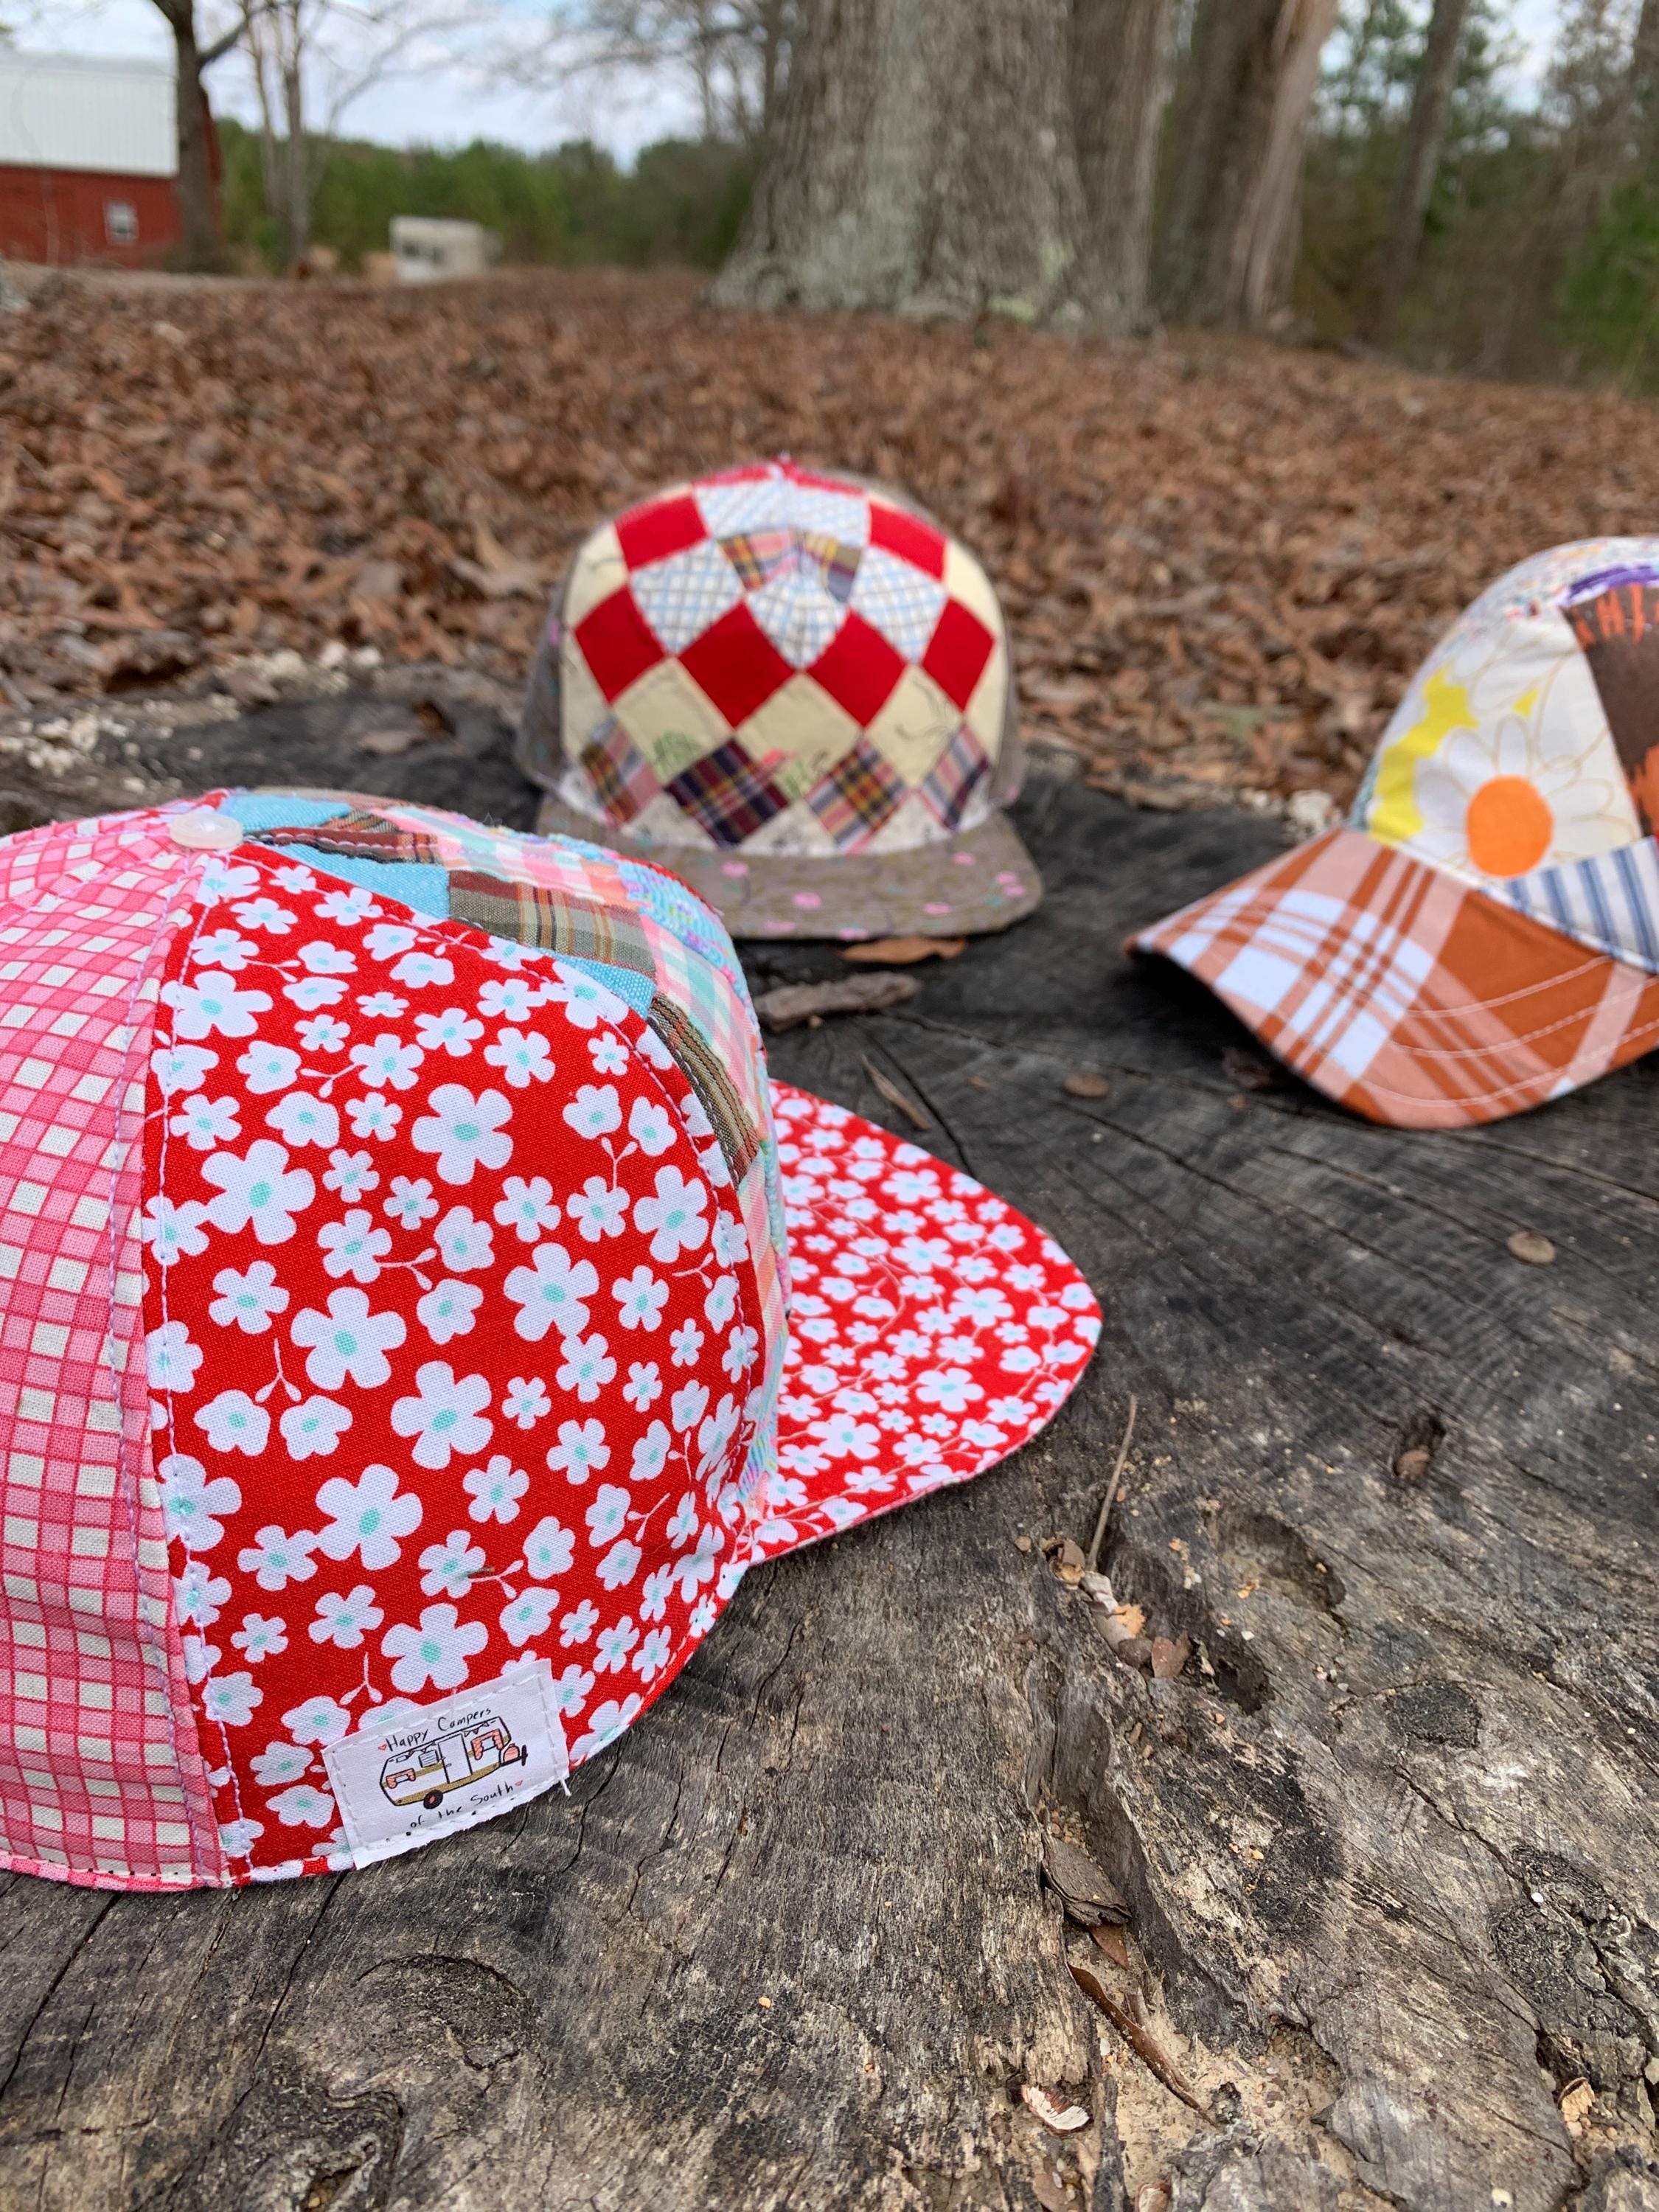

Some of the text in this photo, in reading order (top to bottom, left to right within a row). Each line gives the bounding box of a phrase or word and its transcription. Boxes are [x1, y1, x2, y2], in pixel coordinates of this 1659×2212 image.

[386, 1708, 491, 1751] Happy Campers
[410, 1781, 513, 1829] of the South
